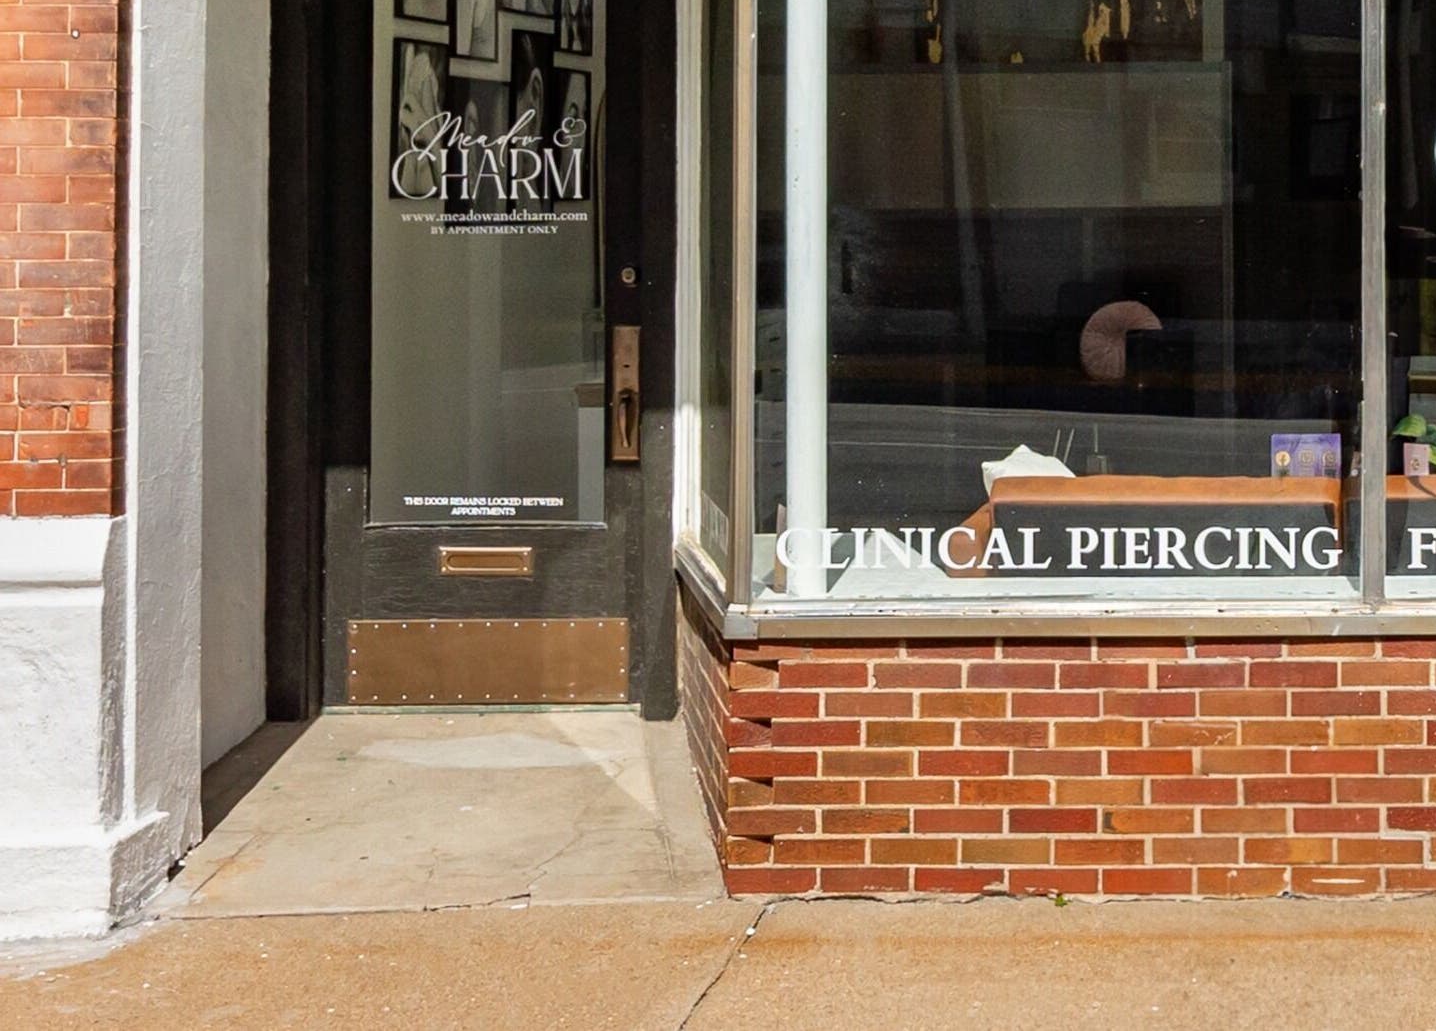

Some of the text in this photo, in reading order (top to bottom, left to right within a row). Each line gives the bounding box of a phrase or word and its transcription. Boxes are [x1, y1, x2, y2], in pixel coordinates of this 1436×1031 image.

[411, 108, 587, 167] Meadow &
[391, 147, 584, 200] CHARM
[401, 209, 588, 222] www.meadowandcharm.com
[430, 225, 559, 235] BY APPOINTMENT ONLY
[404, 496, 564, 507] THIS DOOR REMAINS LOCKED BETWEEN
[451, 506, 516, 516] APPOINTMENTS
[775, 526, 1053, 570] CLINICAL
[1065, 526, 1343, 570] PIERCING
